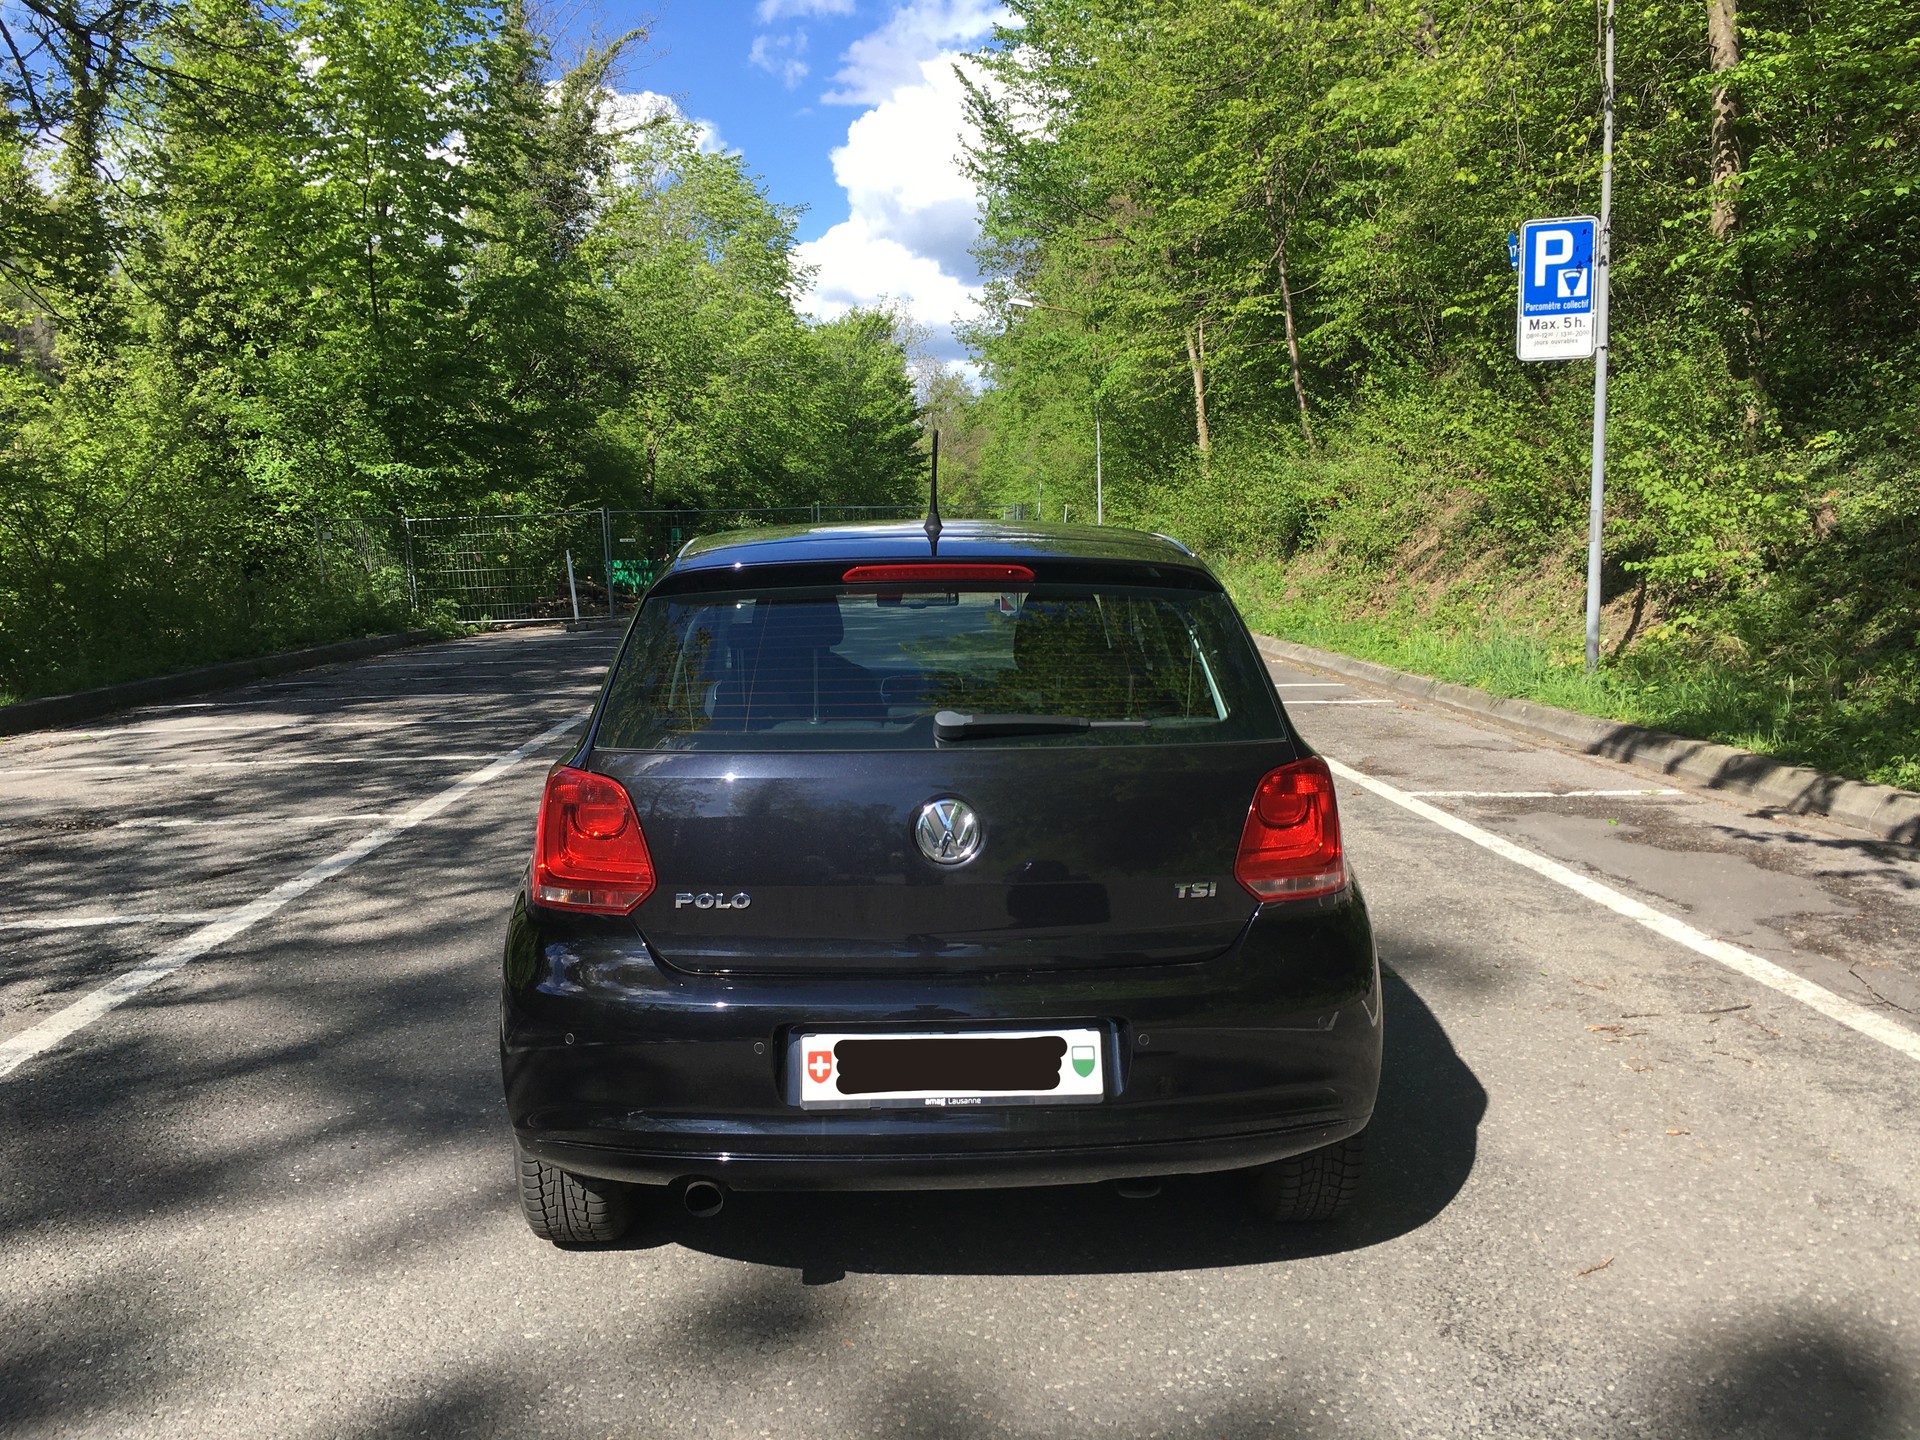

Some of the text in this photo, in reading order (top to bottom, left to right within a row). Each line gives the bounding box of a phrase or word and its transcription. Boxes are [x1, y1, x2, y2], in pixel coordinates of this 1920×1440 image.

[1534, 230, 1573, 286] P
[1525, 299, 1589, 312] Parcomètre collectif
[1529, 319, 1559, 330] Max.
[1174, 881, 1217, 898] TSI
[675, 892, 751, 909] POLO
